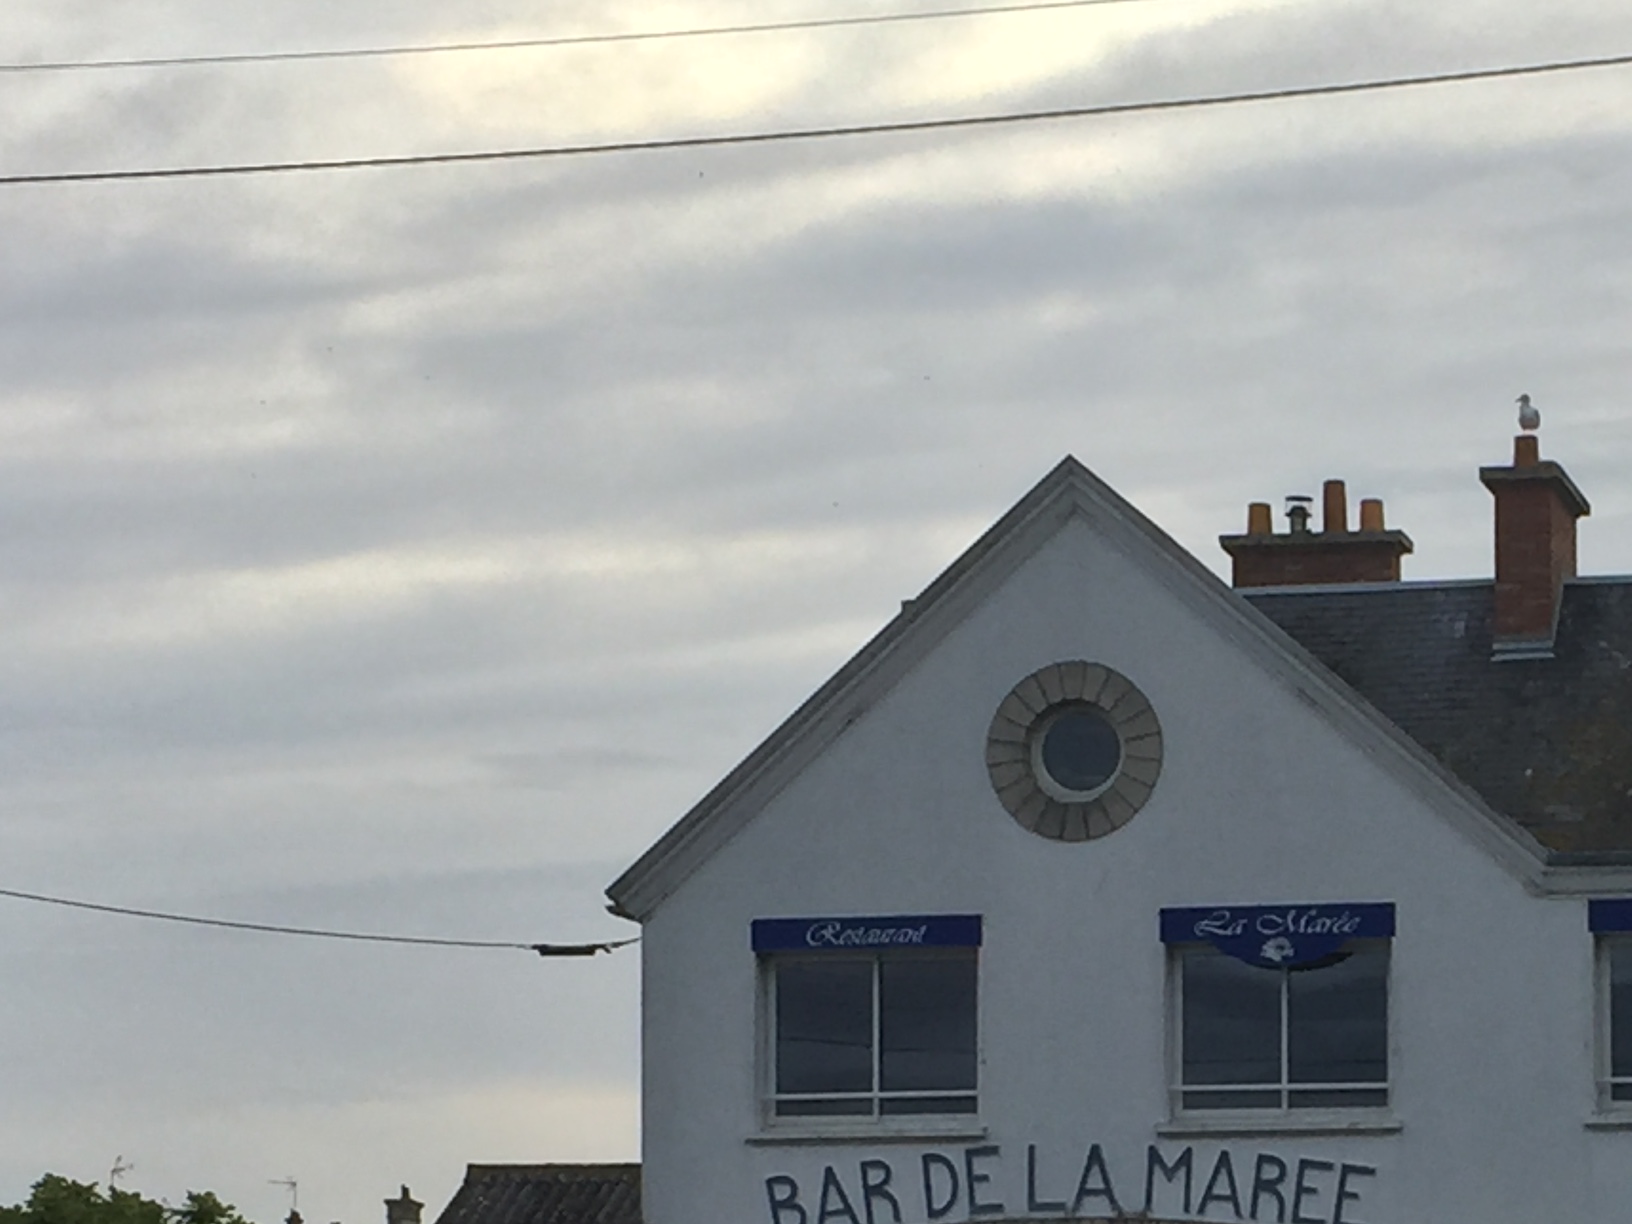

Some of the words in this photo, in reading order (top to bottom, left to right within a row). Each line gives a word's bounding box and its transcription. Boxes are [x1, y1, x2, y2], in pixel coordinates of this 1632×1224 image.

[803, 920, 929, 948] Restaurant
[1193, 909, 1249, 938] La
[1256, 907, 1362, 936] Marée
[921, 1144, 1005, 1219] DE
[1028, 1143, 1124, 1218] LA
